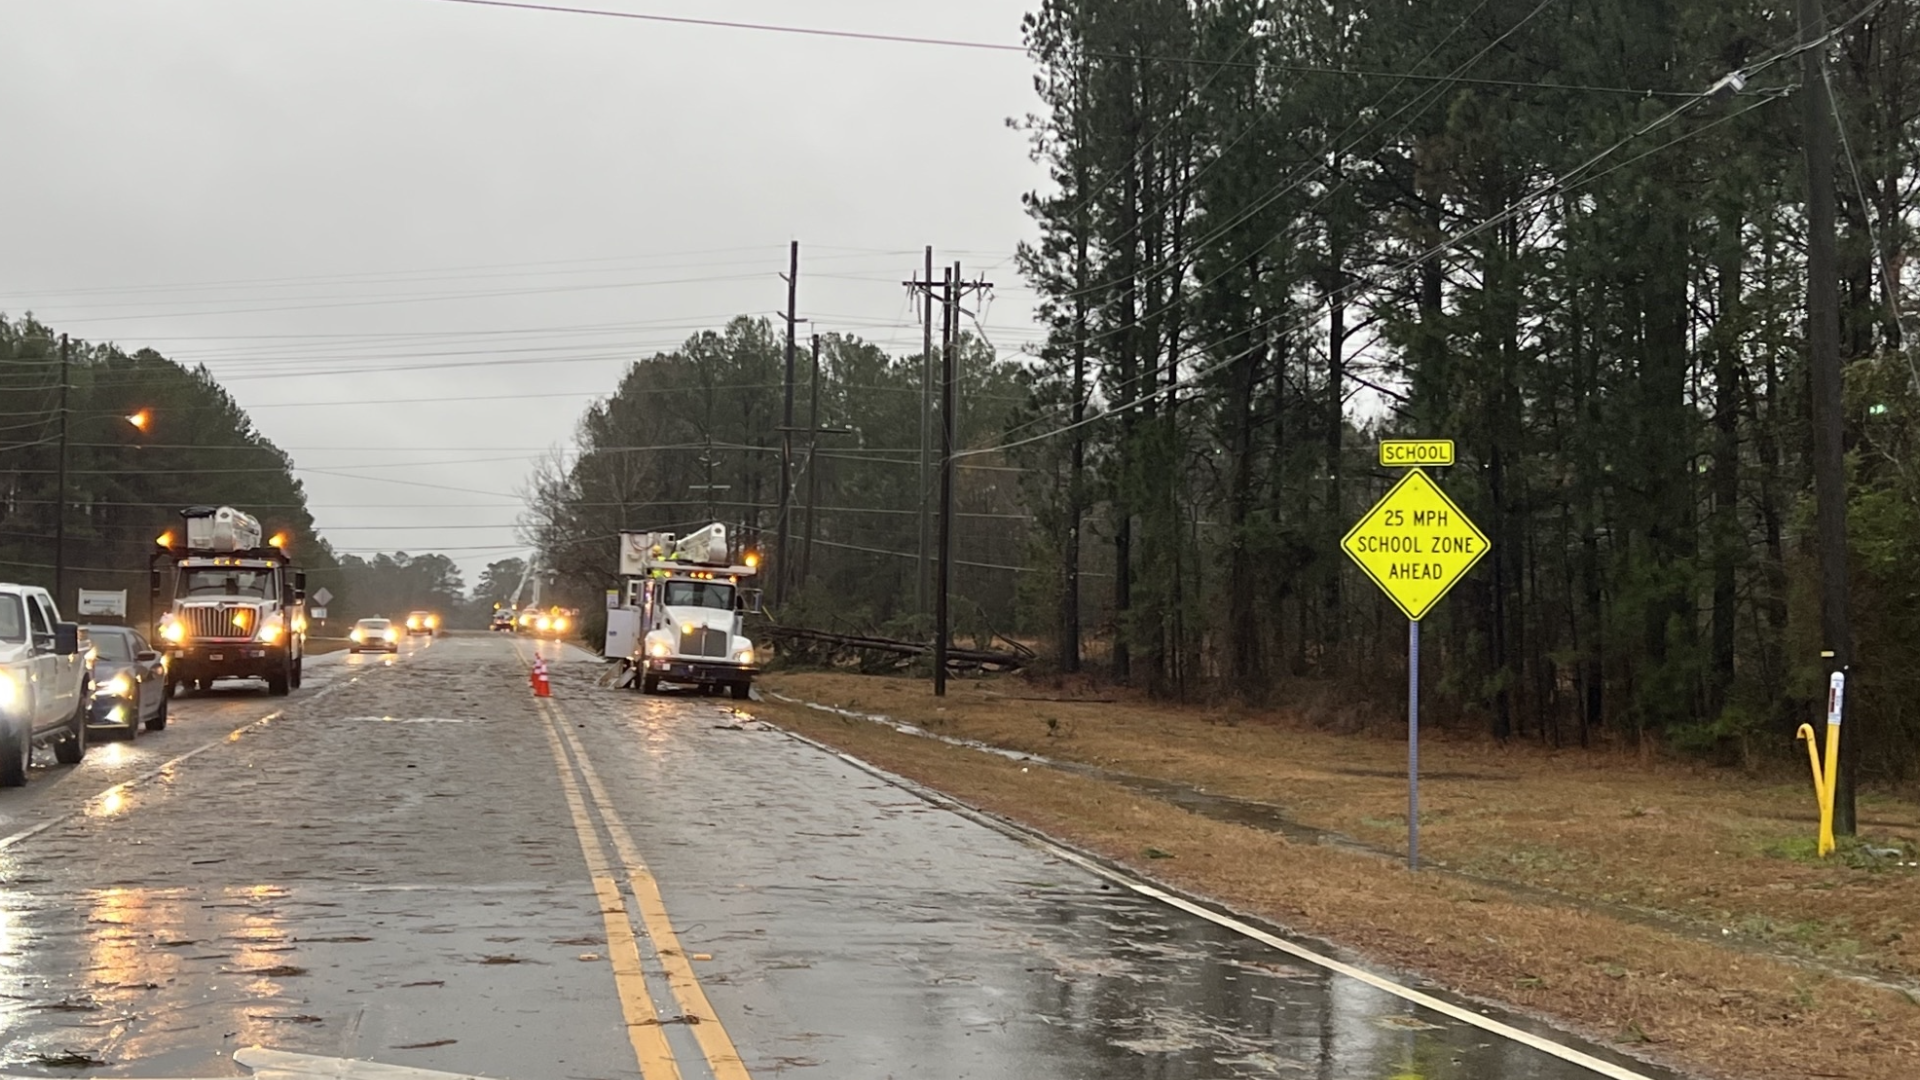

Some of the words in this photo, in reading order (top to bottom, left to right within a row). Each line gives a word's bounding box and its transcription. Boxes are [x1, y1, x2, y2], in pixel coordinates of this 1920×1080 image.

[1385, 446, 1448, 460] SCHOOL
[1384, 510, 1404, 526] 25
[1413, 511, 1448, 526] MPH
[1357, 536, 1423, 553] SCHOOL
[1431, 537, 1474, 553] ZONE
[1388, 563, 1443, 580] AHEAD
